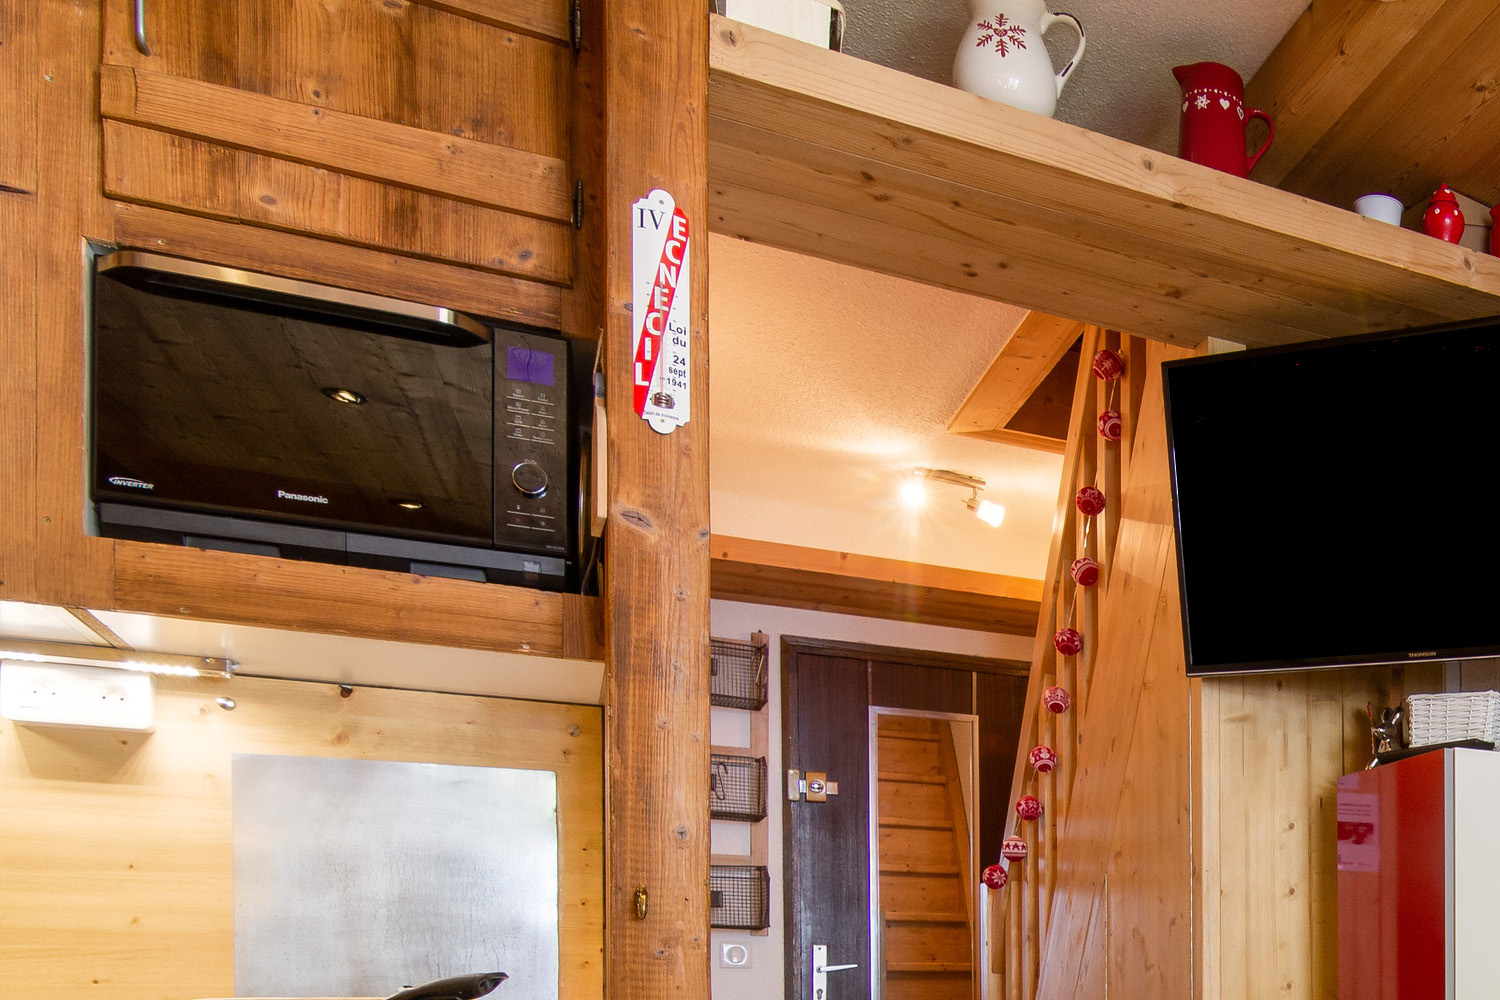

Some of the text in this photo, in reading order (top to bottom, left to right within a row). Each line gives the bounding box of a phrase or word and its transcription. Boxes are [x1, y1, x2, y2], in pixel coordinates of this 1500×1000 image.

[637, 207, 666, 230] IV
[669, 321, 687, 337] Loi
[672, 336, 687, 348] du
[673, 355, 686, 367] 24
[668, 366, 687, 379] sept
[666, 377, 687, 390] 1941
[113, 479, 154, 490] INVERTER
[277, 490, 329, 504] Panasonic
